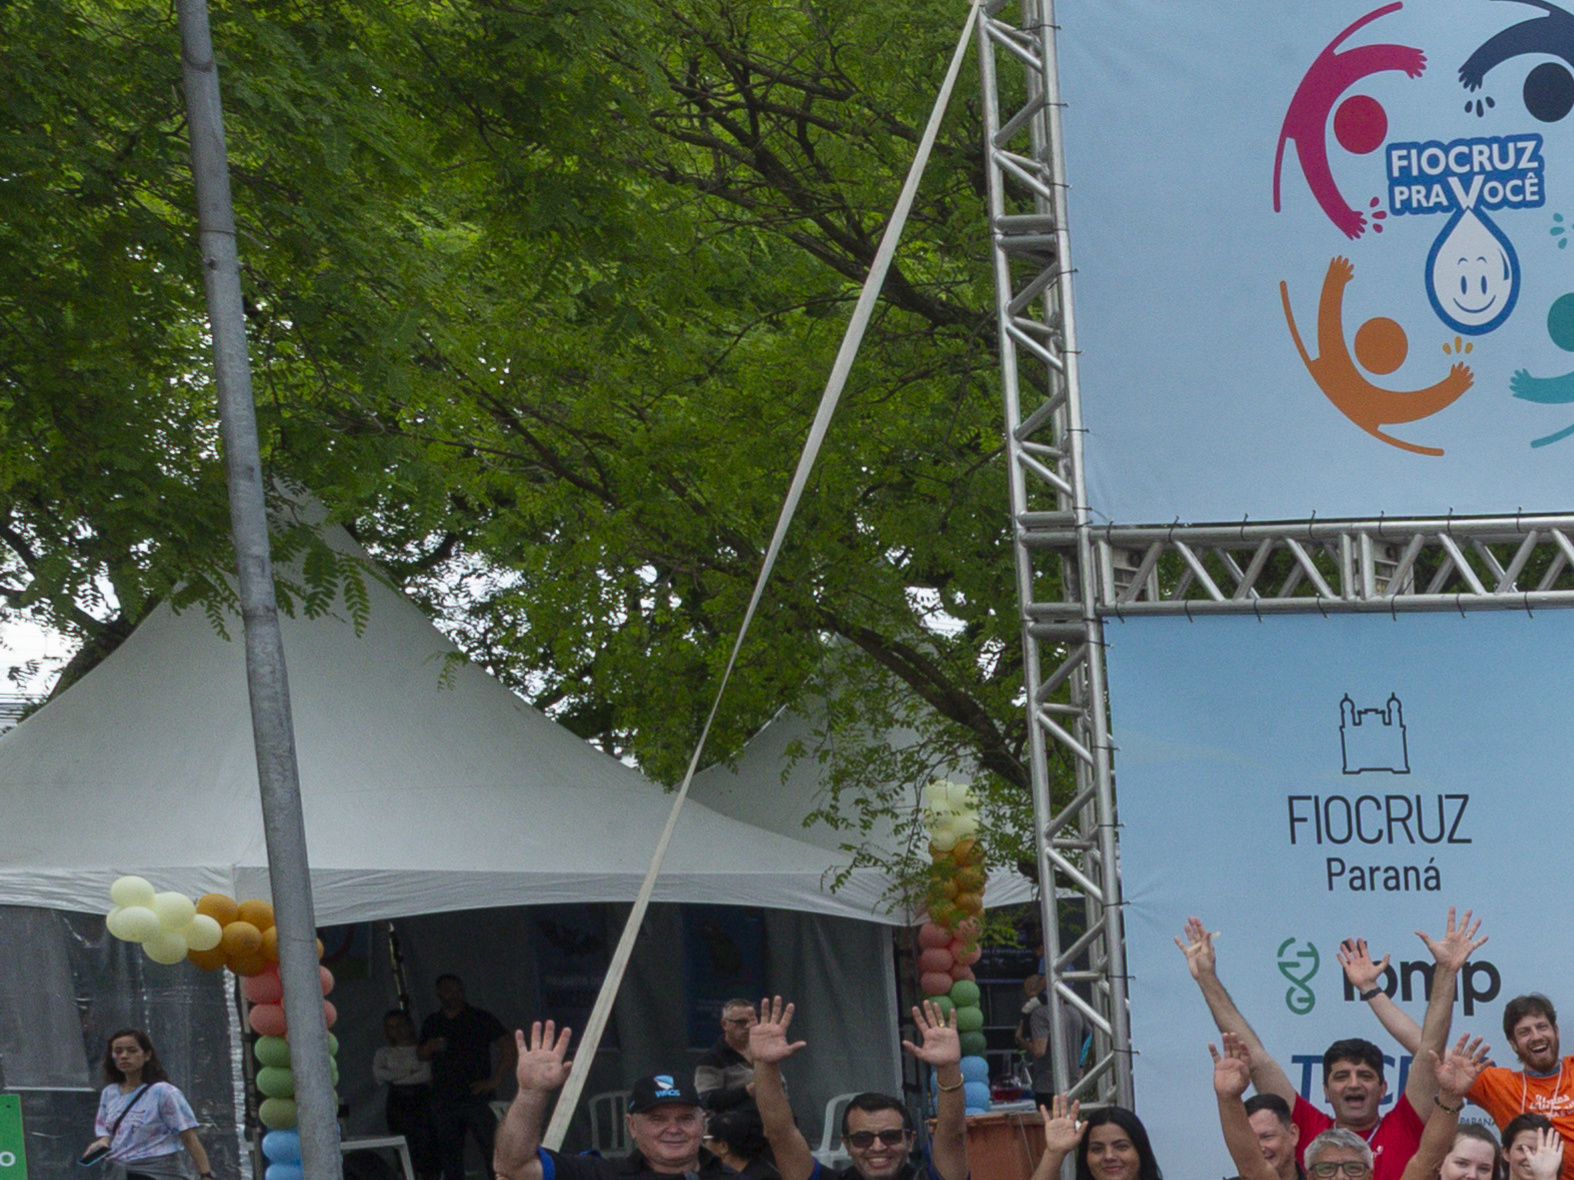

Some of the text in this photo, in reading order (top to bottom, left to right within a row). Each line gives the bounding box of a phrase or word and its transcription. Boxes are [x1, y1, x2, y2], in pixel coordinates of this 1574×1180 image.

[1391, 141, 1538, 177] FIOCRUZ
[1394, 172, 1539, 210] PRA VOCÊ
[1288, 794, 1472, 845] FIOCRUZ
[1327, 856, 1441, 892] Paraná
